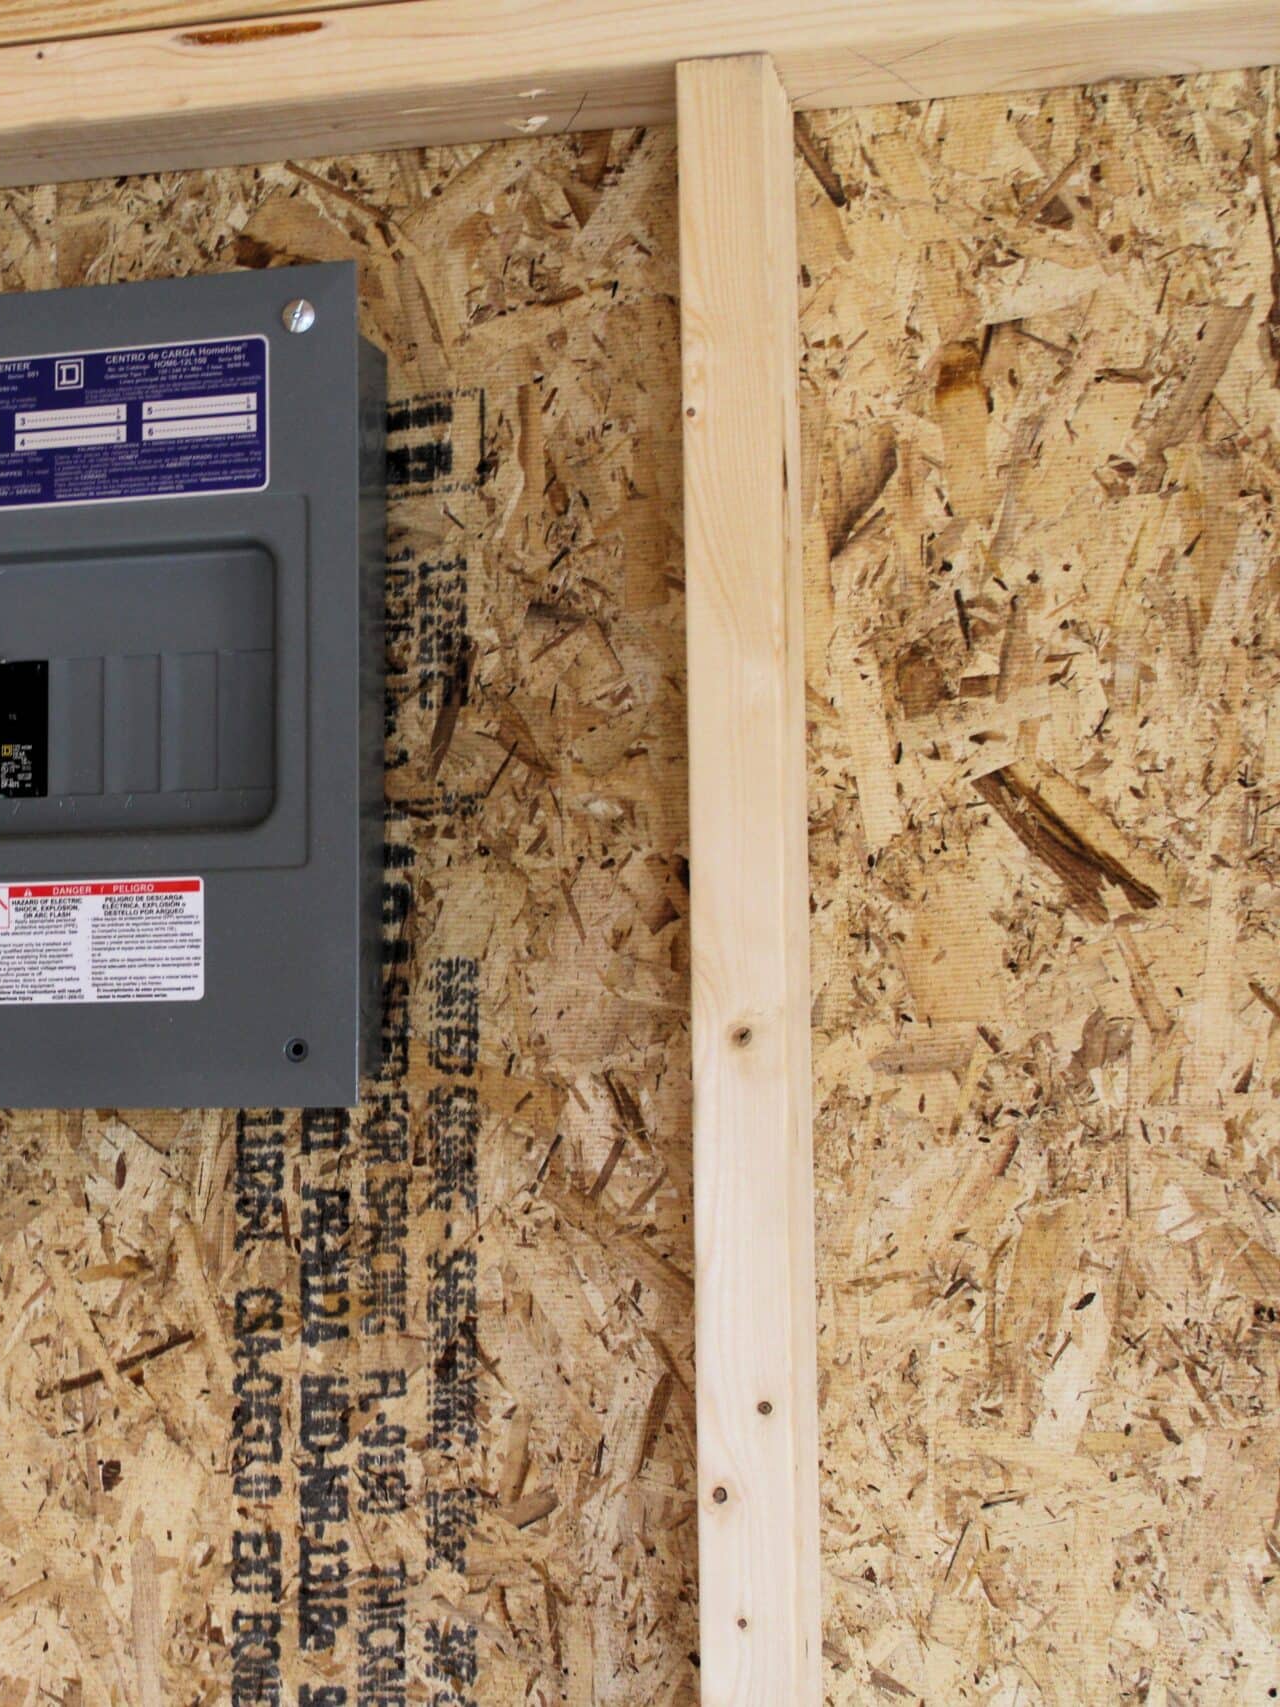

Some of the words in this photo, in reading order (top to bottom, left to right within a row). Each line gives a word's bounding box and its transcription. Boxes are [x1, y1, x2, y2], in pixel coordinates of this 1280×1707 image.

[105, 352, 145, 365] CENTRO
[148, 351, 159, 361] de
[162, 348, 196, 360] CARGA
[147, 407, 152, 415] 5
[21, 418, 25, 426] 3
[148, 428, 153, 436] 6
[20, 438, 25, 446] 4
[52, 886, 92, 895] DANGER
[113, 884, 154, 893] PELIGRO
[155, 908, 184, 916] ARQUEO
[361, 1090, 409, 1163] FOR
[360, 1177, 409, 1336] SPACING
